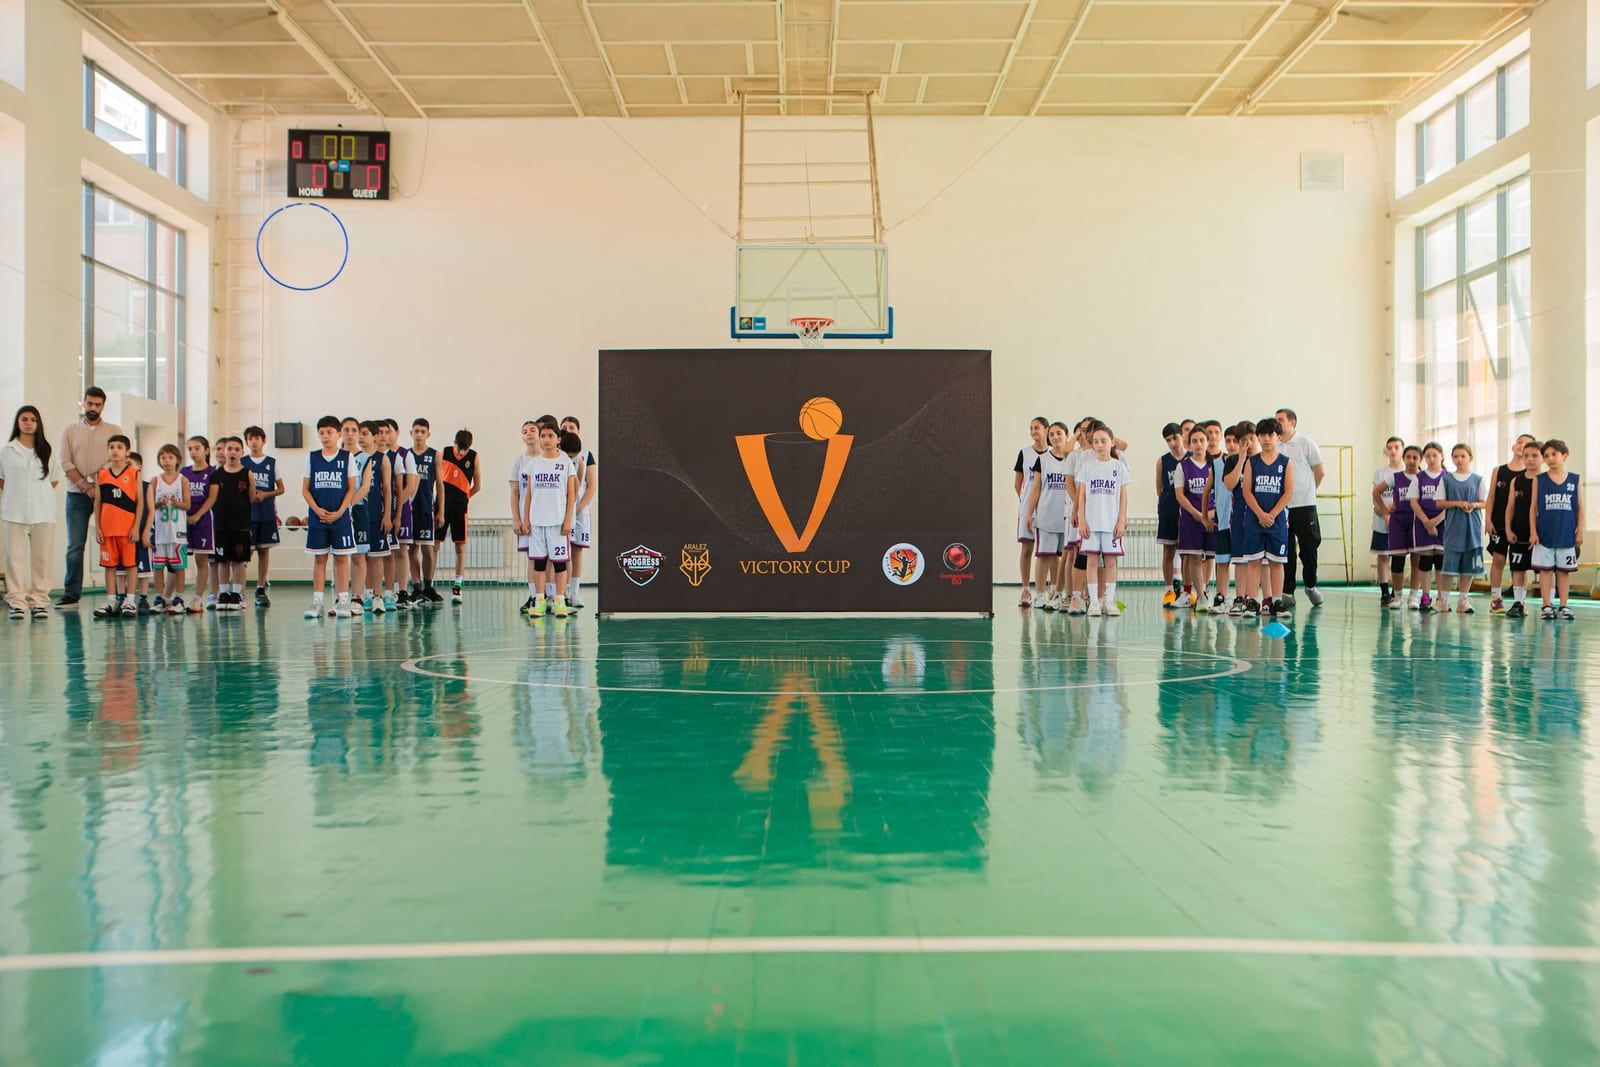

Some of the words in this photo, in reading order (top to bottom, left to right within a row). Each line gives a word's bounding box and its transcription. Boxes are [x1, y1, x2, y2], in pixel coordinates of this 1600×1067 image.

[298, 187, 324, 197] HOME
[352, 188, 379, 199] GUEST
[424, 455, 433, 463] 23
[265, 463, 270, 471] 4
[337, 460, 344, 469] 11
[554, 463, 564, 471] 23
[253, 472, 269, 482] RAK
[314, 471, 342, 482] MIRAK
[535, 473, 560, 482] MIRAK
[1113, 469, 1118, 477] 5
[1090, 479, 1116, 489] MIRAK
[1256, 475, 1282, 486] MIRAK
[190, 481, 206, 491] RAK
[112, 488, 121, 498] 10
[1545, 493, 1573, 504] MIRAK
[160, 506, 179, 523] 30
[272, 532, 278, 541] 4
[400, 526, 410, 537] 71
[420, 529, 432, 539] 23
[201, 538, 206, 548] 7
[342, 536, 351, 547] 11
[379, 540, 385, 549] 7
[1111, 539, 1117, 548] 5
[554, 546, 566, 556] 23
[683, 543, 708, 551] ARALEZ
[101, 551, 110, 561] 10
[623, 558, 660, 566] PROGRESS
[739, 560, 813, 574] VICTORY
[815, 560, 851, 574] CUP
